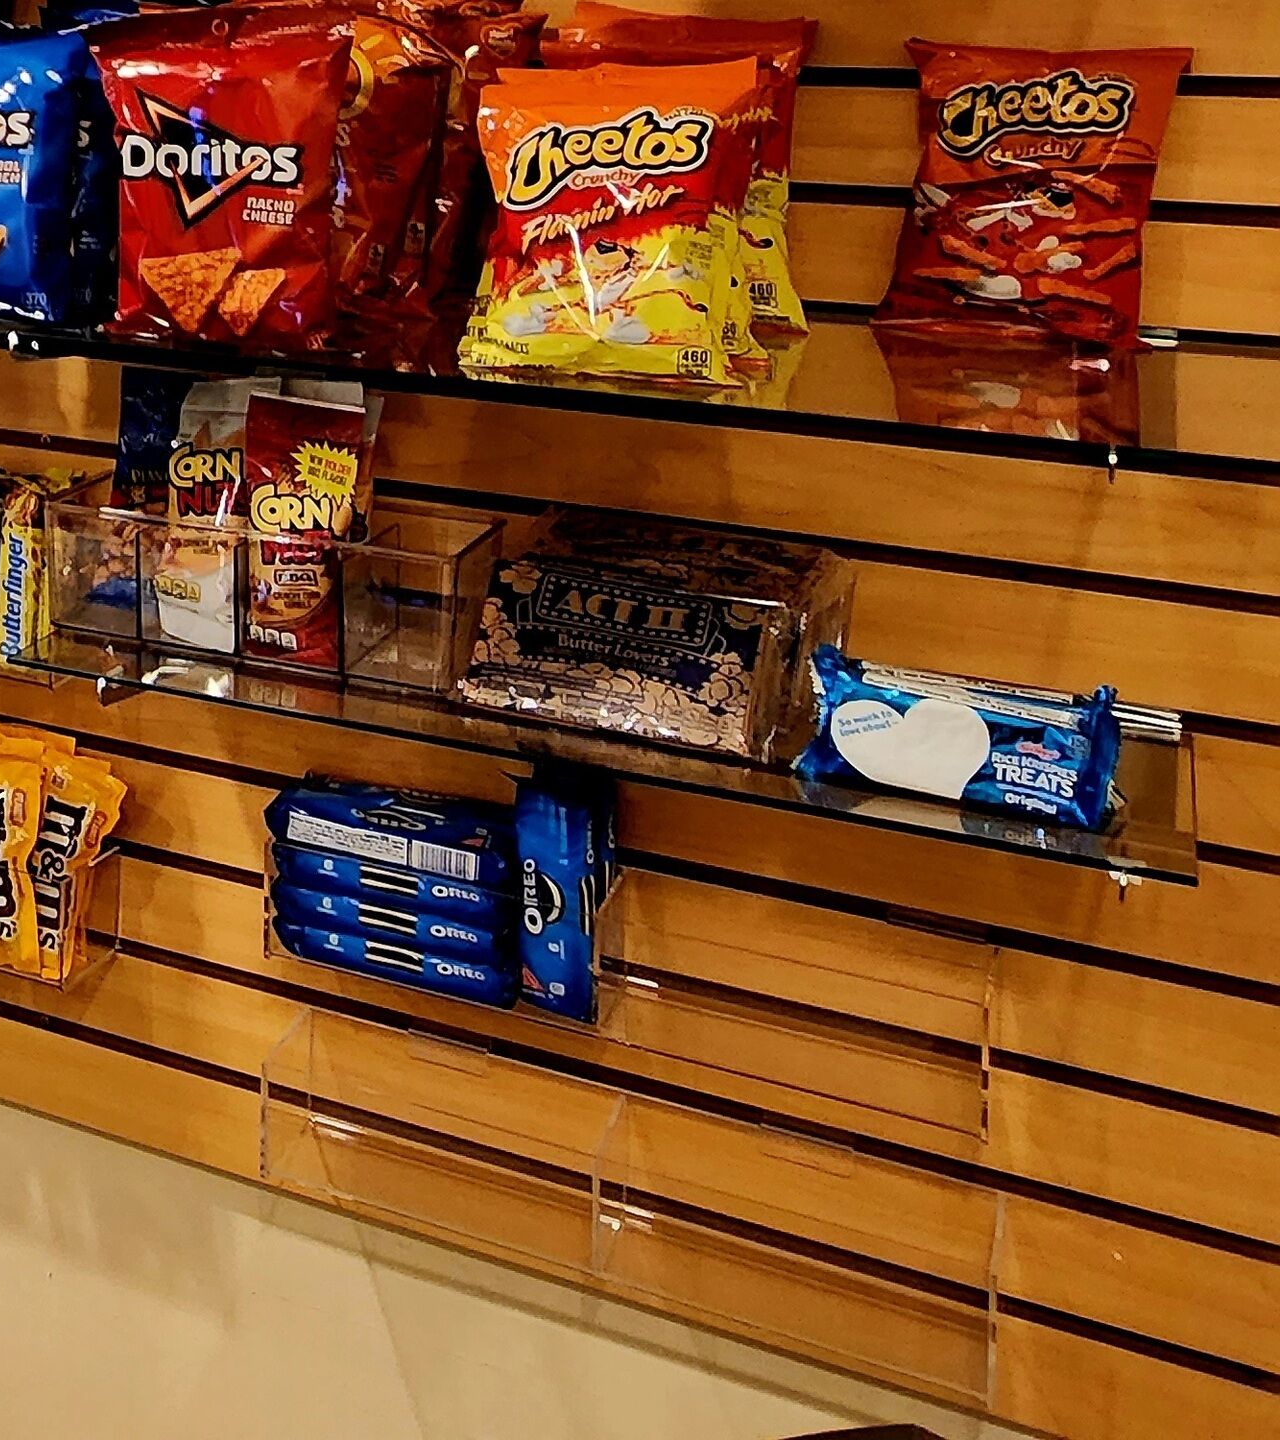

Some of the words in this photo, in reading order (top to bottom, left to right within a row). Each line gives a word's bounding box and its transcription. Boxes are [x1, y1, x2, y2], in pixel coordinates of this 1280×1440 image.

[942, 77, 1125, 147] Cheetos
[121, 134, 298, 192] Doritos
[511, 114, 700, 201] Cheetos
[572, 170, 639, 189] Crunchy
[242, 210, 295, 226] CHEESE
[247, 197, 295, 213] NACHO
[749, 282, 773, 296] 460
[682, 350, 709, 364] 460
[170, 447, 241, 488] CORN
[251, 484, 330, 535] CORN
[0, 535, 28, 659] Butterfinger
[555, 588, 639, 624] ACT
[646, 605, 690, 633] II
[558, 633, 612, 656] Butter
[615, 640, 671, 668] Lovers
[992, 762, 1074, 798] TREATS
[1004, 792, 1057, 815] Original
[431, 884, 481, 904] OREO
[522, 858, 544, 935] OREO
[430, 924, 479, 944] OREO
[436, 962, 486, 982] OREO
